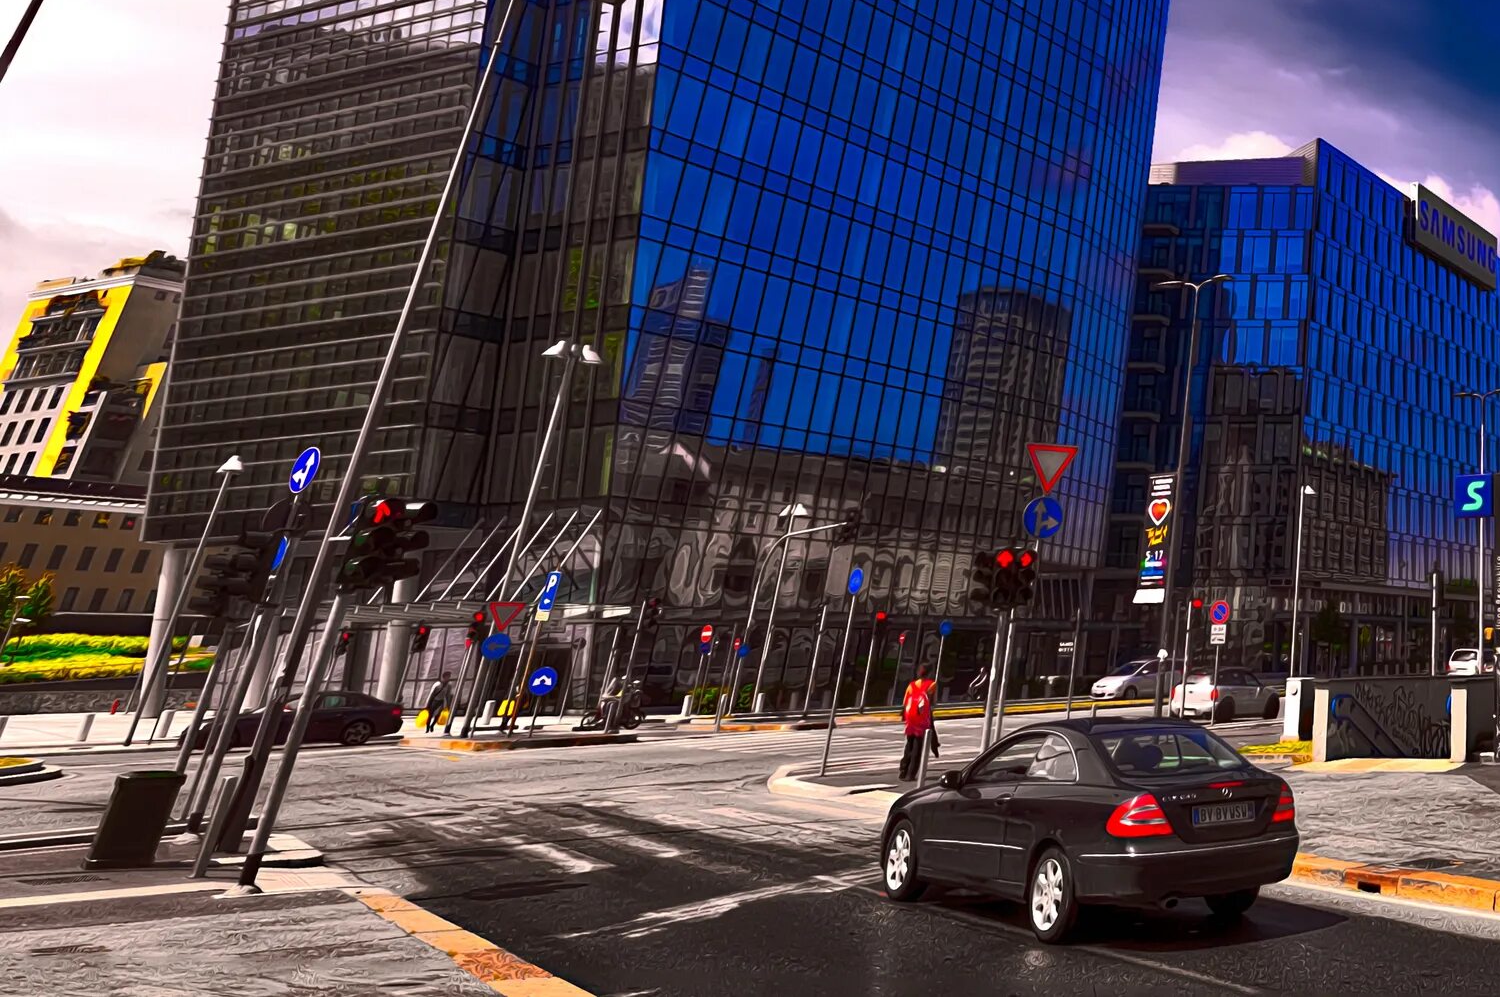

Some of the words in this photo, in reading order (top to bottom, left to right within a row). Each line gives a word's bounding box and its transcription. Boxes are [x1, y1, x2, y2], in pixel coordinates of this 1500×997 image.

[1420, 200, 1496, 274] SAMSUNG
[1462, 481, 1486, 511] S
[546, 575, 558, 593] P
